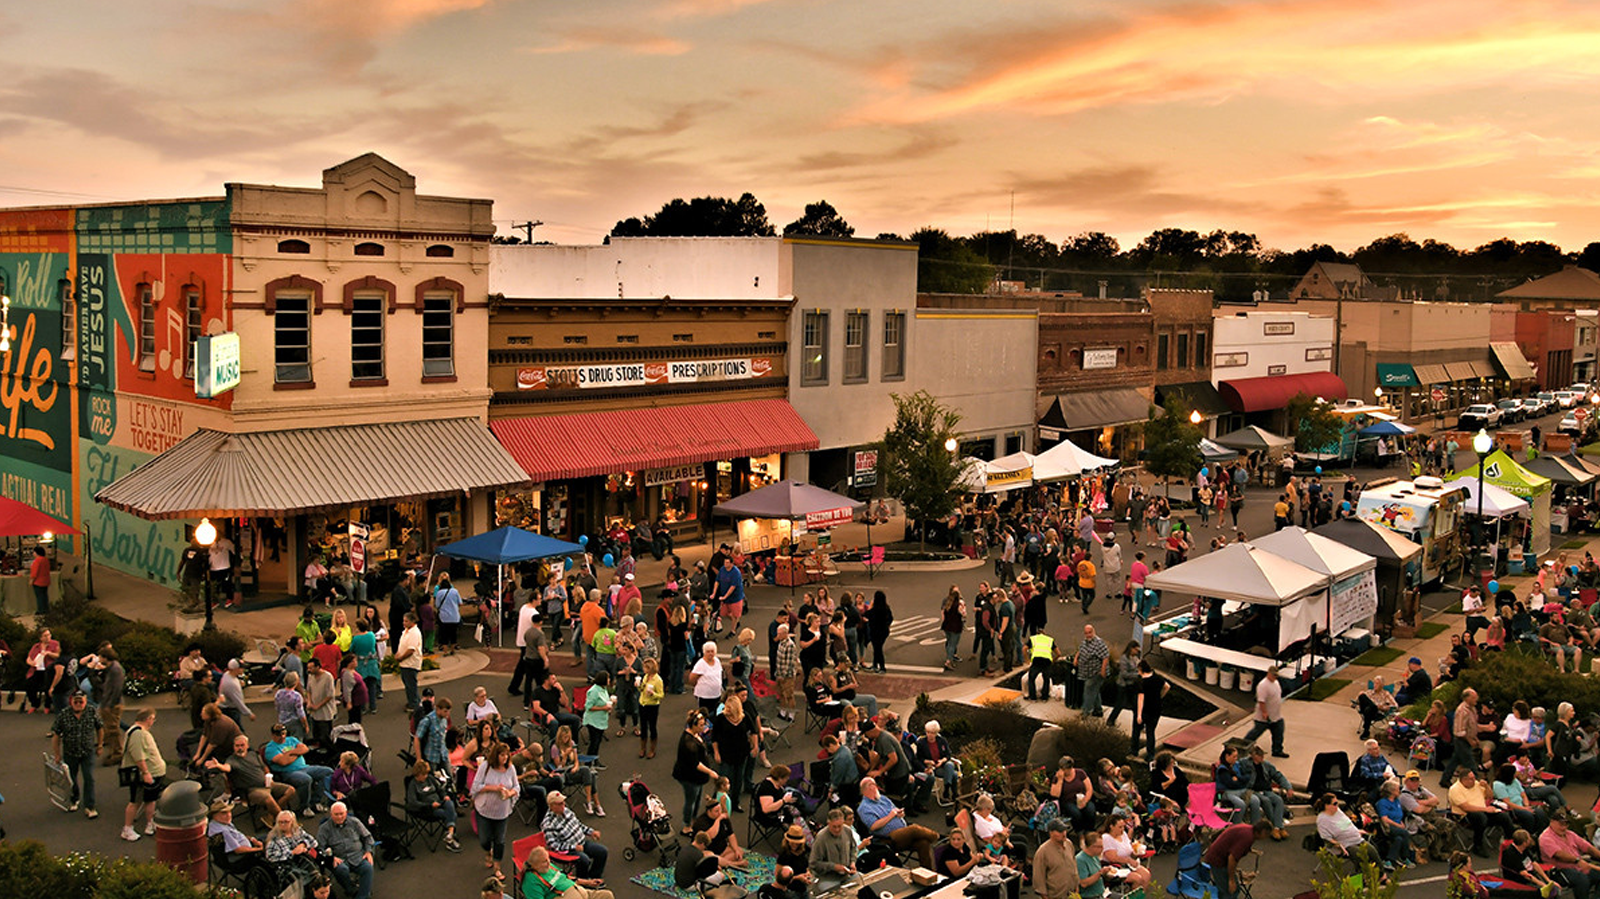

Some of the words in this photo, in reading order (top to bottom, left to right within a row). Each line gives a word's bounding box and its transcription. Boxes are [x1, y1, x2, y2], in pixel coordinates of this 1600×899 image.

[15, 252, 53, 308] Roll
[81, 266, 89, 303] HAVE
[81, 307, 90, 362] RATHER
[90, 265, 105, 375] JESUS
[216, 360, 239, 387] MUSIC
[588, 367, 614, 383] DRUG
[615, 366, 644, 381] STORE
[672, 361, 747, 378] PRESCRIPTIONS
[92, 396, 111, 415] ROCK
[129, 401, 157, 430] LET'S
[160, 407, 183, 435] STAY
[91, 414, 113, 437] me
[645, 465, 702, 484] AVAILABLE
[2, 472, 39, 510] ACTUAL
[41, 483, 69, 520] REAL
[92, 505, 179, 581] Darlin'
